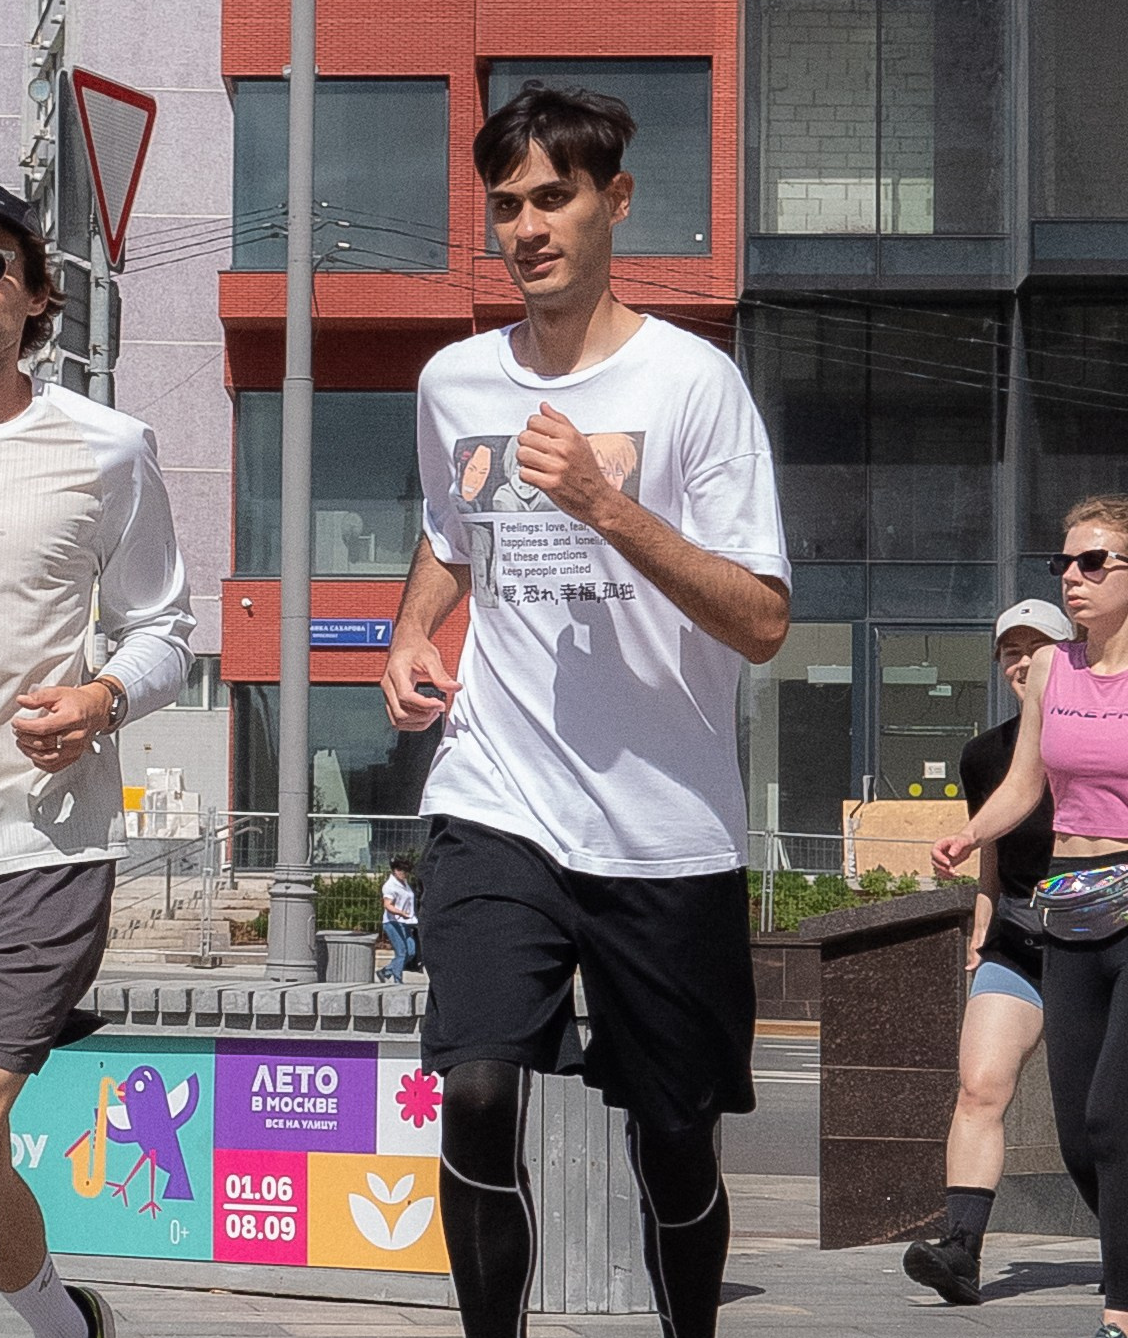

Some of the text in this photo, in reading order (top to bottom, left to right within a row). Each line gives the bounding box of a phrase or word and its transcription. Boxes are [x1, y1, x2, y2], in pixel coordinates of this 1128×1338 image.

[500, 522, 543, 534] Feelings:
[545, 522, 568, 532] love,
[500, 537, 549, 549] happiness
[553, 536, 571, 546] and
[502, 549, 588, 561] all these emotions
[502, 563, 592, 578] keep people united
[375, 625, 387, 640] 7
[1050, 705, 1128, 720] NIKE PR
[251, 1064, 339, 1095] ЛЕТО
[252, 1096, 338, 1114] В МОСКВЕ
[265, 1118, 338, 1131] ВСЕ НА УЛИЦУ!
[225, 1174, 293, 1202] 01.06
[170, 1219, 190, 1245] 0+
[225, 1213, 296, 1241] 08.09
